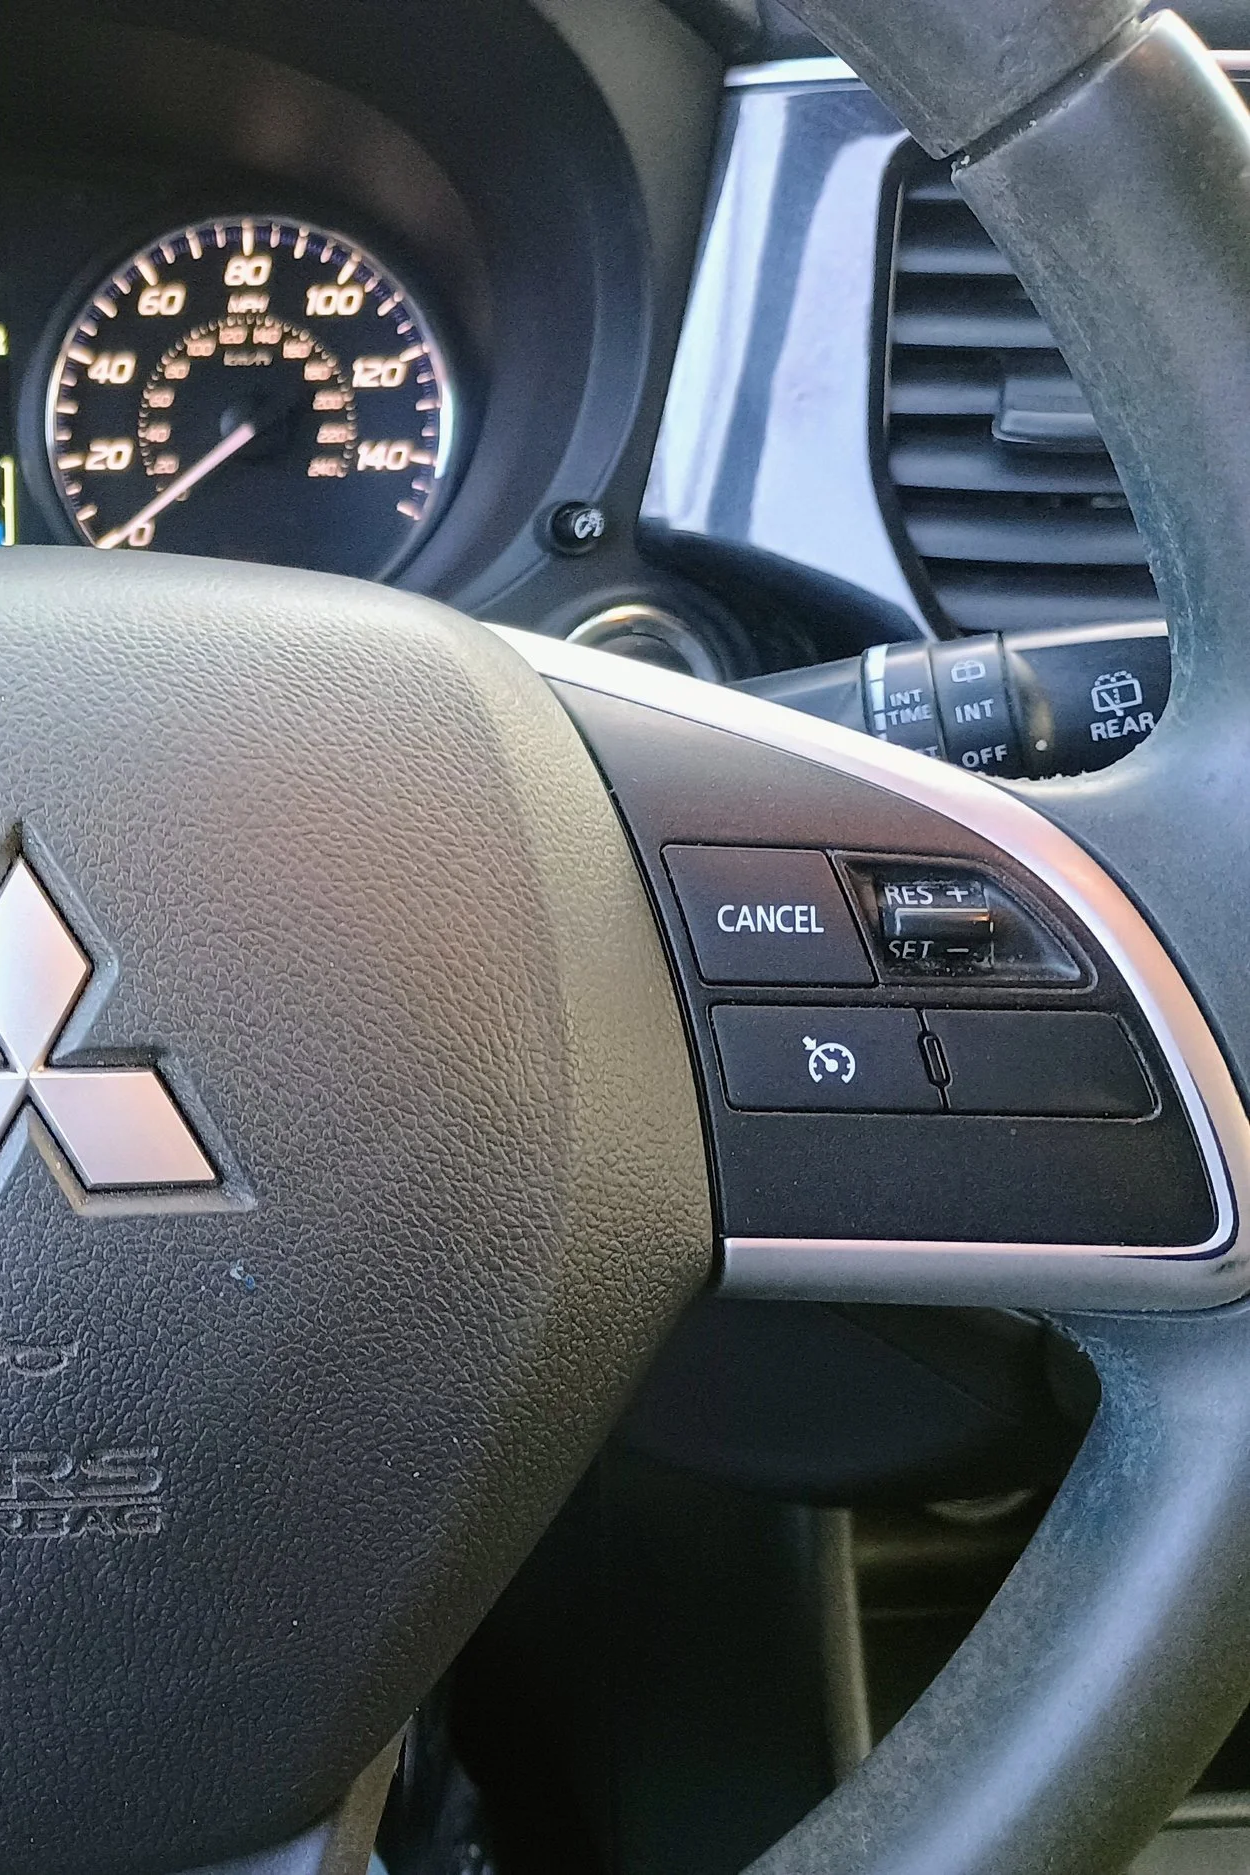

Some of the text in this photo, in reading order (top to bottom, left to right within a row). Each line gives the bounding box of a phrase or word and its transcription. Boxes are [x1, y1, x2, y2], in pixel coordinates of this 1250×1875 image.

[224, 255, 272, 286] 80
[138, 283, 186, 316] 60
[306, 284, 363, 316] 100
[88, 351, 136, 384] 40
[352, 356, 408, 387] 120
[85, 437, 133, 471] 20
[357, 440, 411, 471] 140
[889, 687, 923, 707] INT
[954, 698, 994, 724] INT
[886, 703, 933, 726] TIME
[1089, 711, 1158, 742] REAR
[961, 743, 1008, 768] OFF
[884, 885, 934, 905] RES
[717, 904, 825, 935] CANCEL
[888, 940, 935, 959] SET
